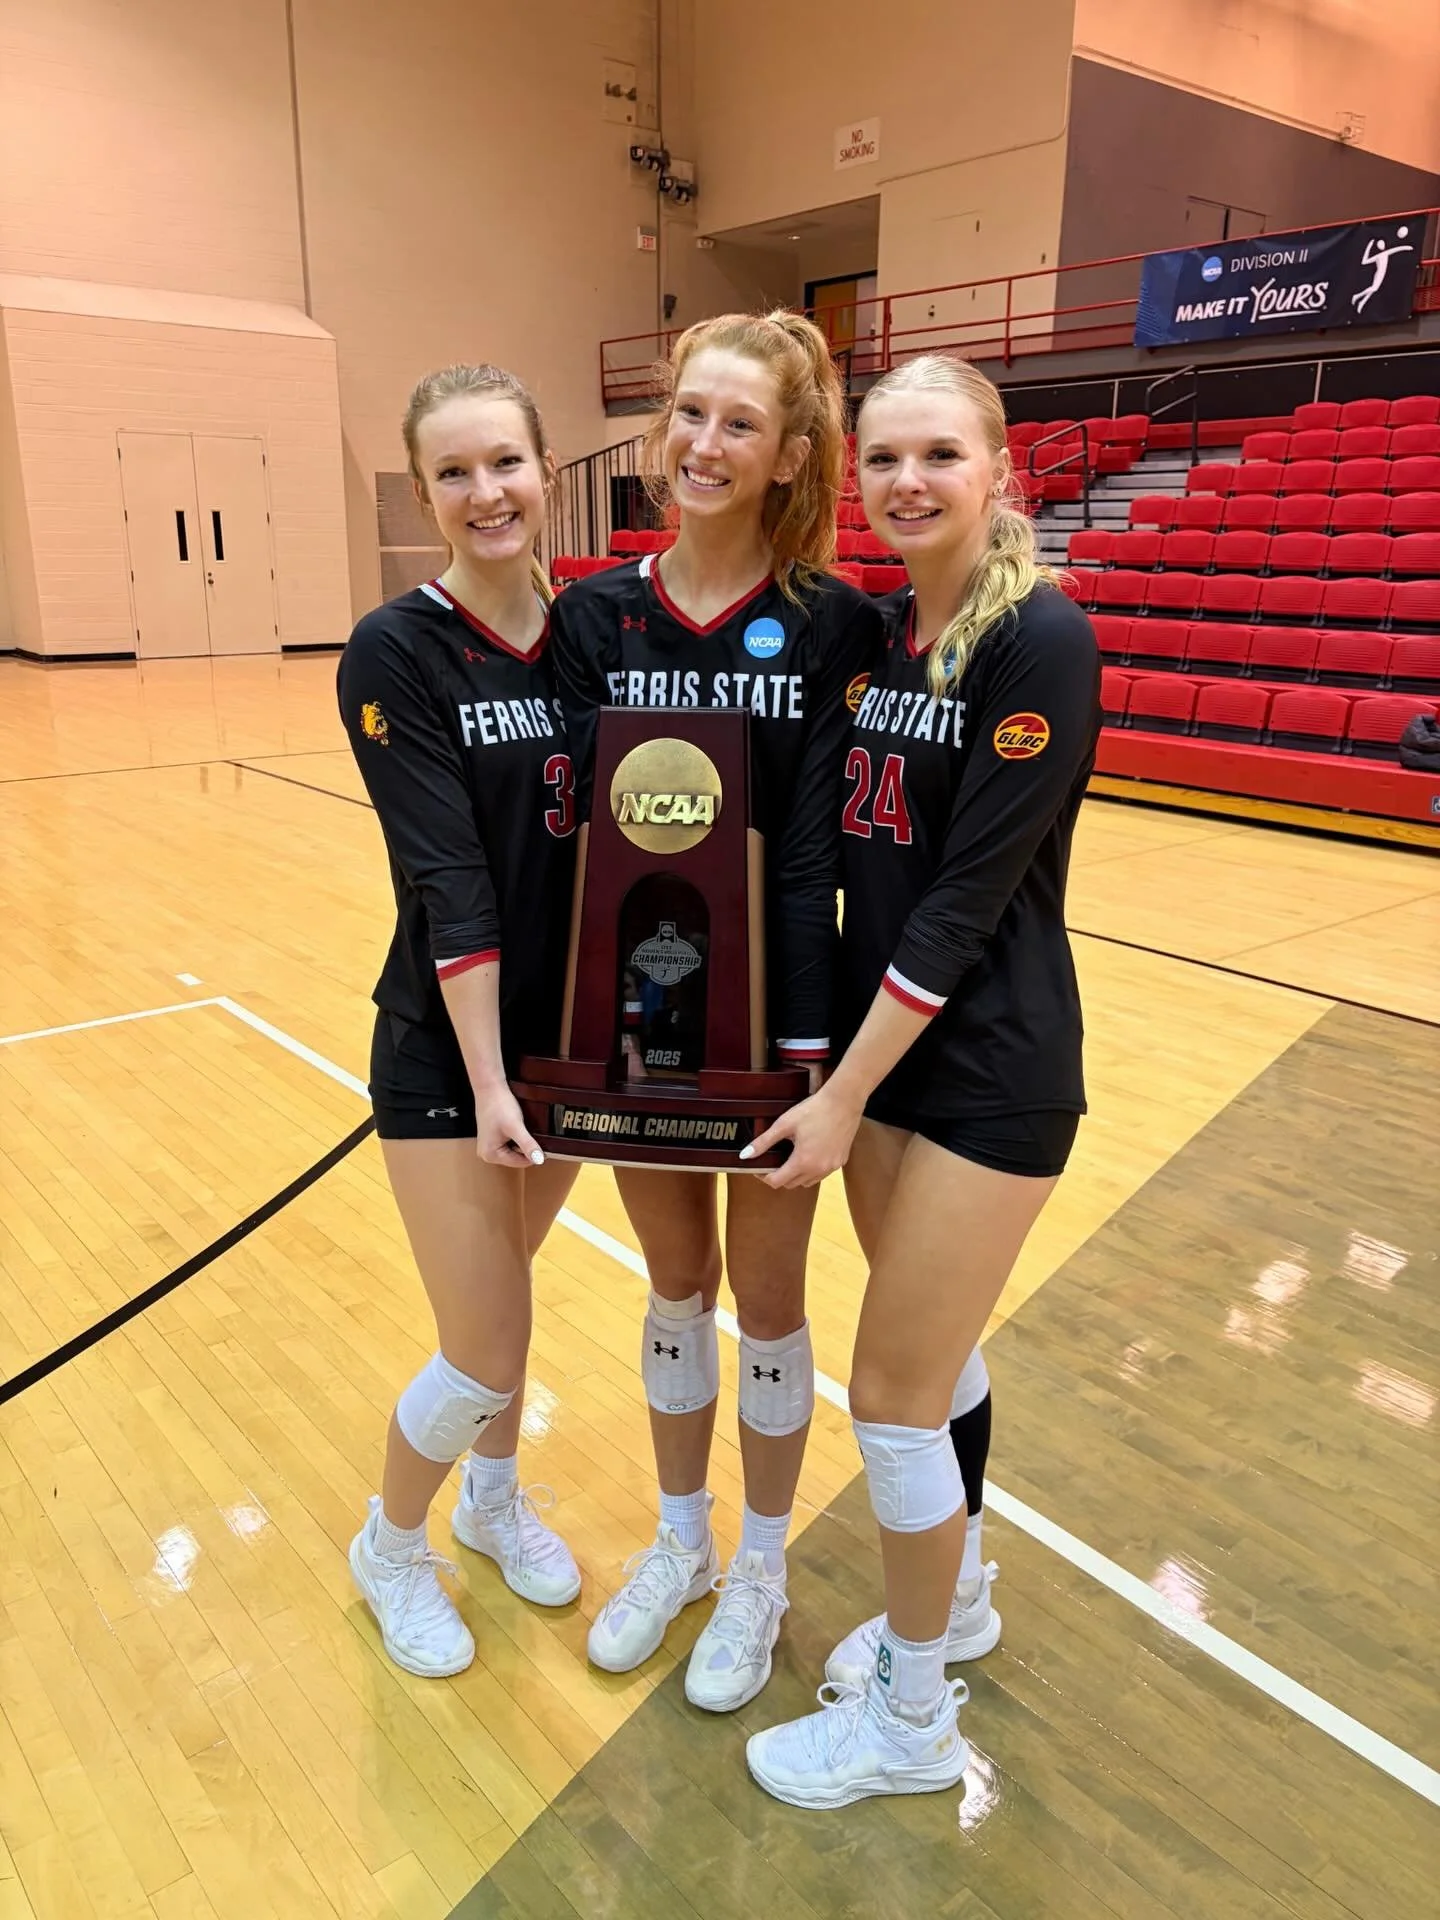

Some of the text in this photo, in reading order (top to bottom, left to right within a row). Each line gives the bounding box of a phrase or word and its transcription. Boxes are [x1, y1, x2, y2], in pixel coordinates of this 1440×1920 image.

[840, 141, 875, 162] SMOKING
[852, 129, 864, 144] NO
[1230, 249, 1309, 273] DIVISION II
[1175, 277, 1329, 323] MAKE IT YOURS
[749, 636, 783, 648] NCAA
[711, 672, 803, 719] STATE
[458, 698, 554, 747] FERRIS
[853, 686, 967, 749] RIS STATE
[543, 754, 577, 838] 3
[618, 792, 715, 826] NCAA
[842, 747, 912, 845] 24
[632, 954, 701, 967] CHAMPIONSHIP
[645, 1050, 682, 1066] 2025
[562, 1110, 739, 1141] REGIONAL CHAMPION
